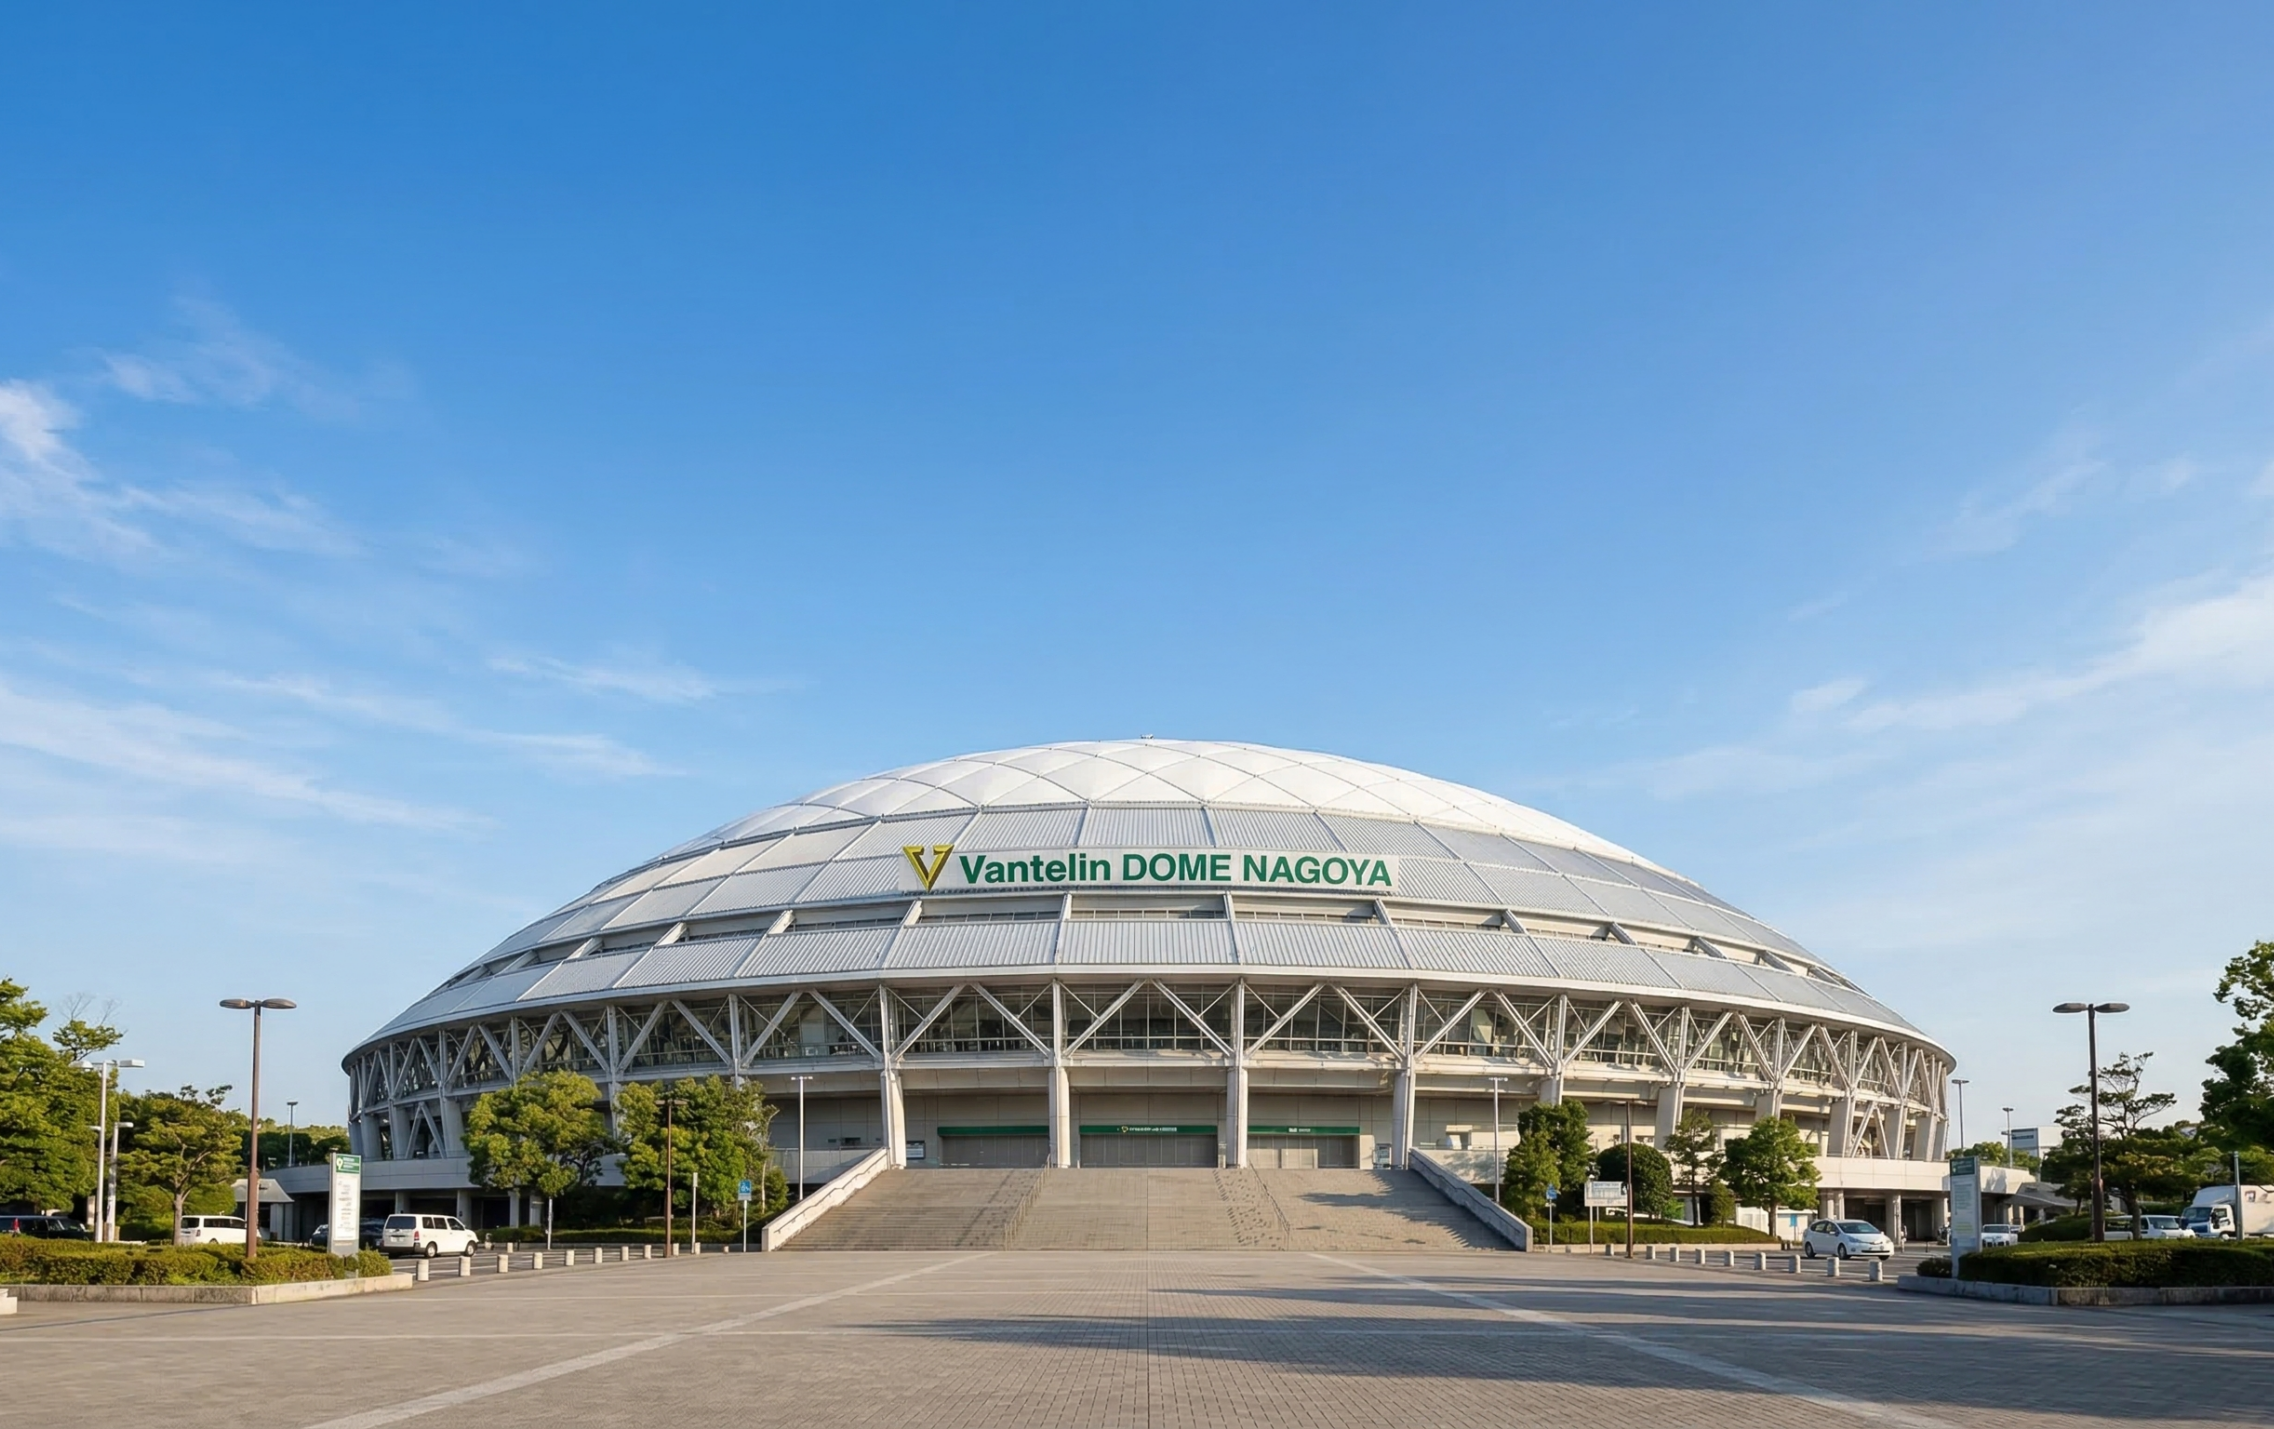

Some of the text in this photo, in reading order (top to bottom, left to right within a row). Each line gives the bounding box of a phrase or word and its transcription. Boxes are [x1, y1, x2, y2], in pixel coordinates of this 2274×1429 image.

[959, 853, 1392, 887] Vantelin DOME NAGOYA
